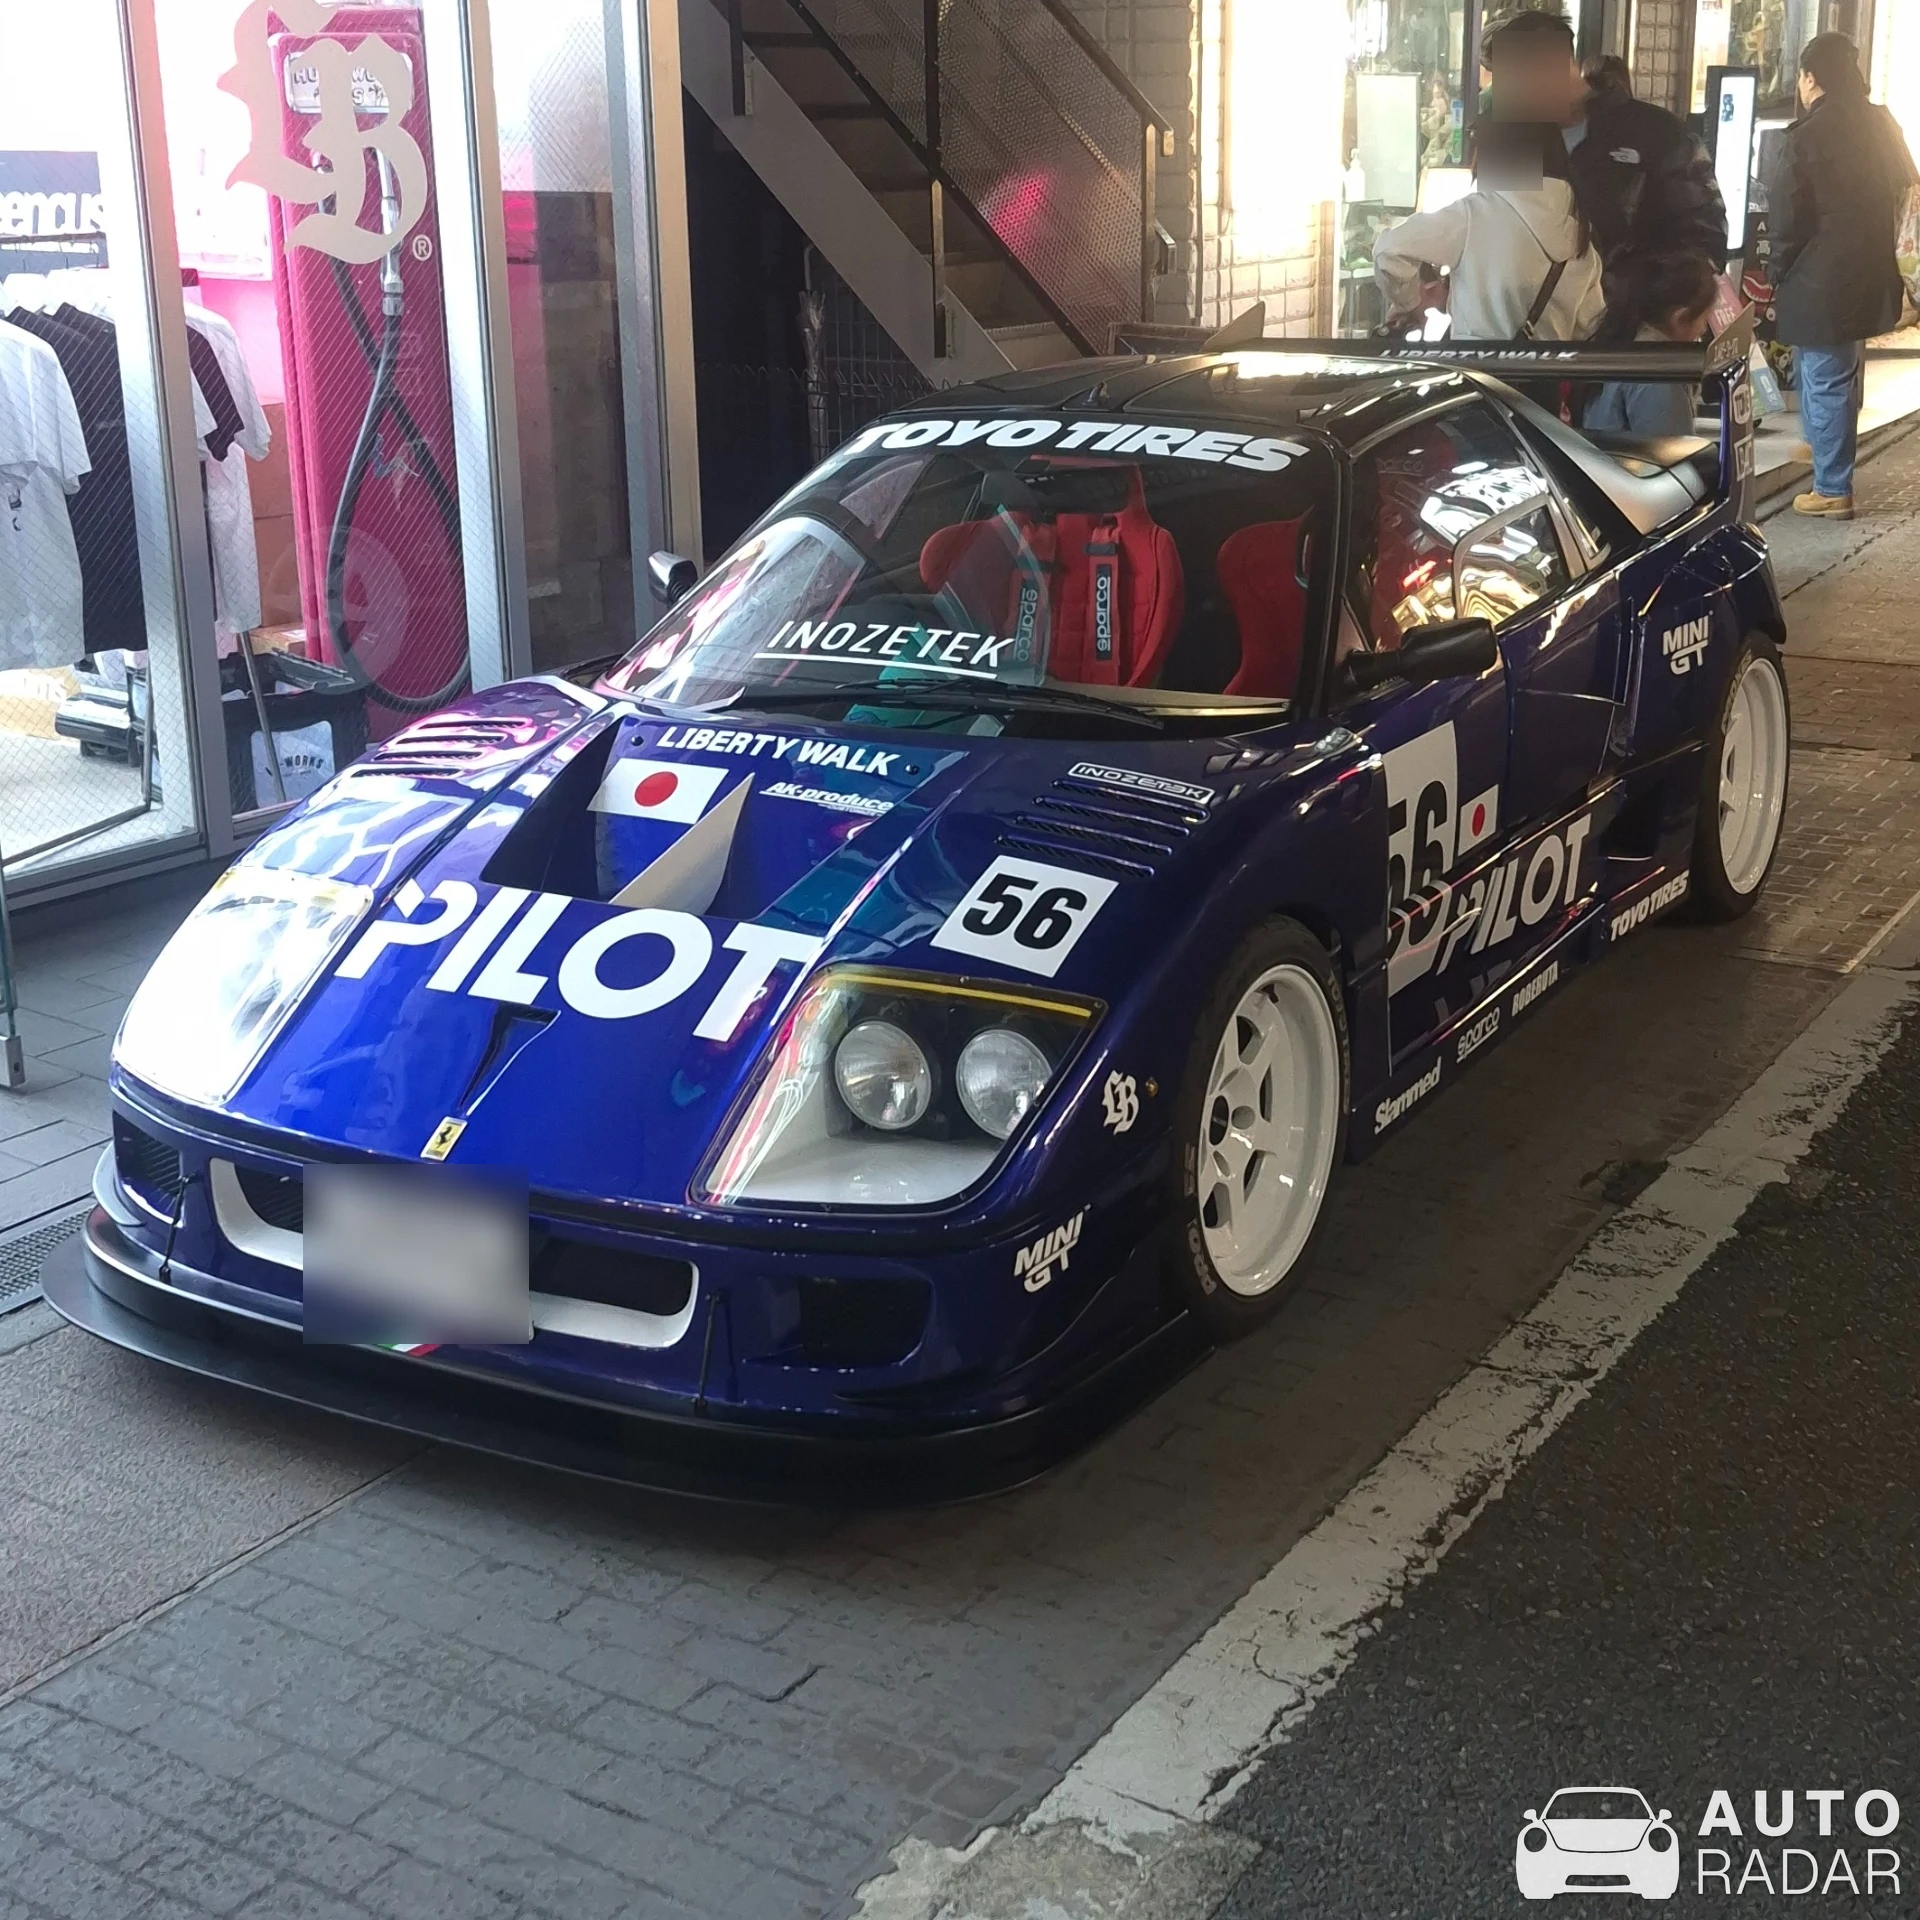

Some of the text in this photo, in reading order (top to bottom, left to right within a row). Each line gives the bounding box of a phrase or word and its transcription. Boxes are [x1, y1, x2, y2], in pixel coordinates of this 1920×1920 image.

[1055, 421, 1310, 472] TIRES
[767, 620, 1016, 668] INOZETEK
[1663, 615, 1709, 656] MINI
[1670, 639, 1709, 675] GT
[656, 726, 901, 776] LIBERTY WALK
[766, 782, 895, 812] AK-produce
[962, 873, 1088, 950] 56
[1436, 813, 1591, 976] PILOT
[1649, 870, 1690, 917] TIRES
[333, 880, 823, 1042] PILOT
[1511, 961, 1559, 1017] ROBERUTA
[1457, 1007, 1500, 1061] sparco
[1374, 1056, 1442, 1135] Slammed
[1014, 1211, 1084, 1276] MINI
[1024, 1237, 1079, 1293] GT
